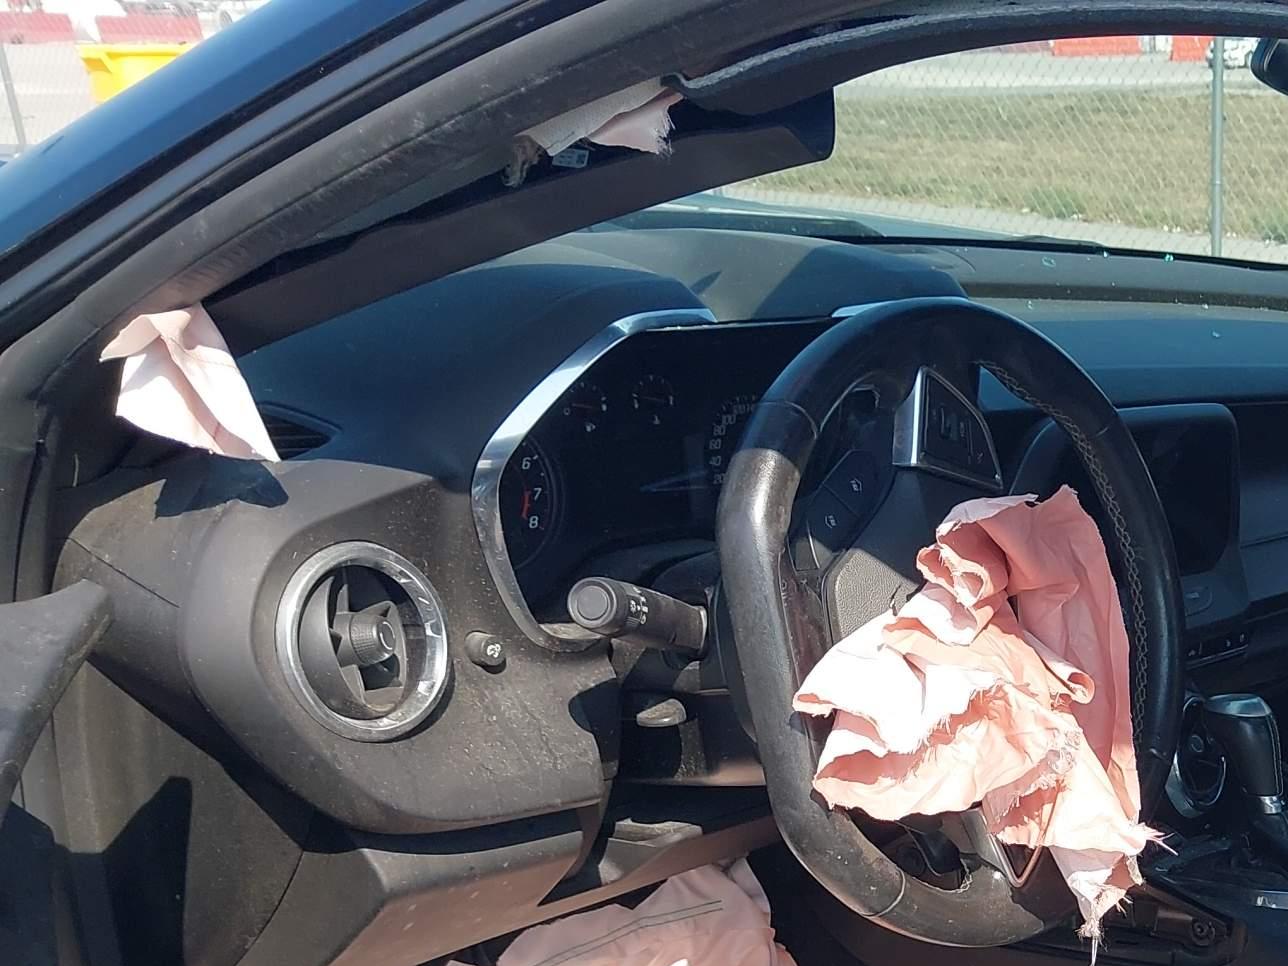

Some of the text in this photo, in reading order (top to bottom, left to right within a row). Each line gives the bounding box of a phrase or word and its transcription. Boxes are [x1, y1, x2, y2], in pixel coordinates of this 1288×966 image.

[713, 424, 726, 436] 80
[709, 438, 721, 450] 60
[521, 457, 531, 470] 6
[709, 455, 721, 466] 40
[533, 487, 542, 501] 7
[528, 515, 539, 529] 8
